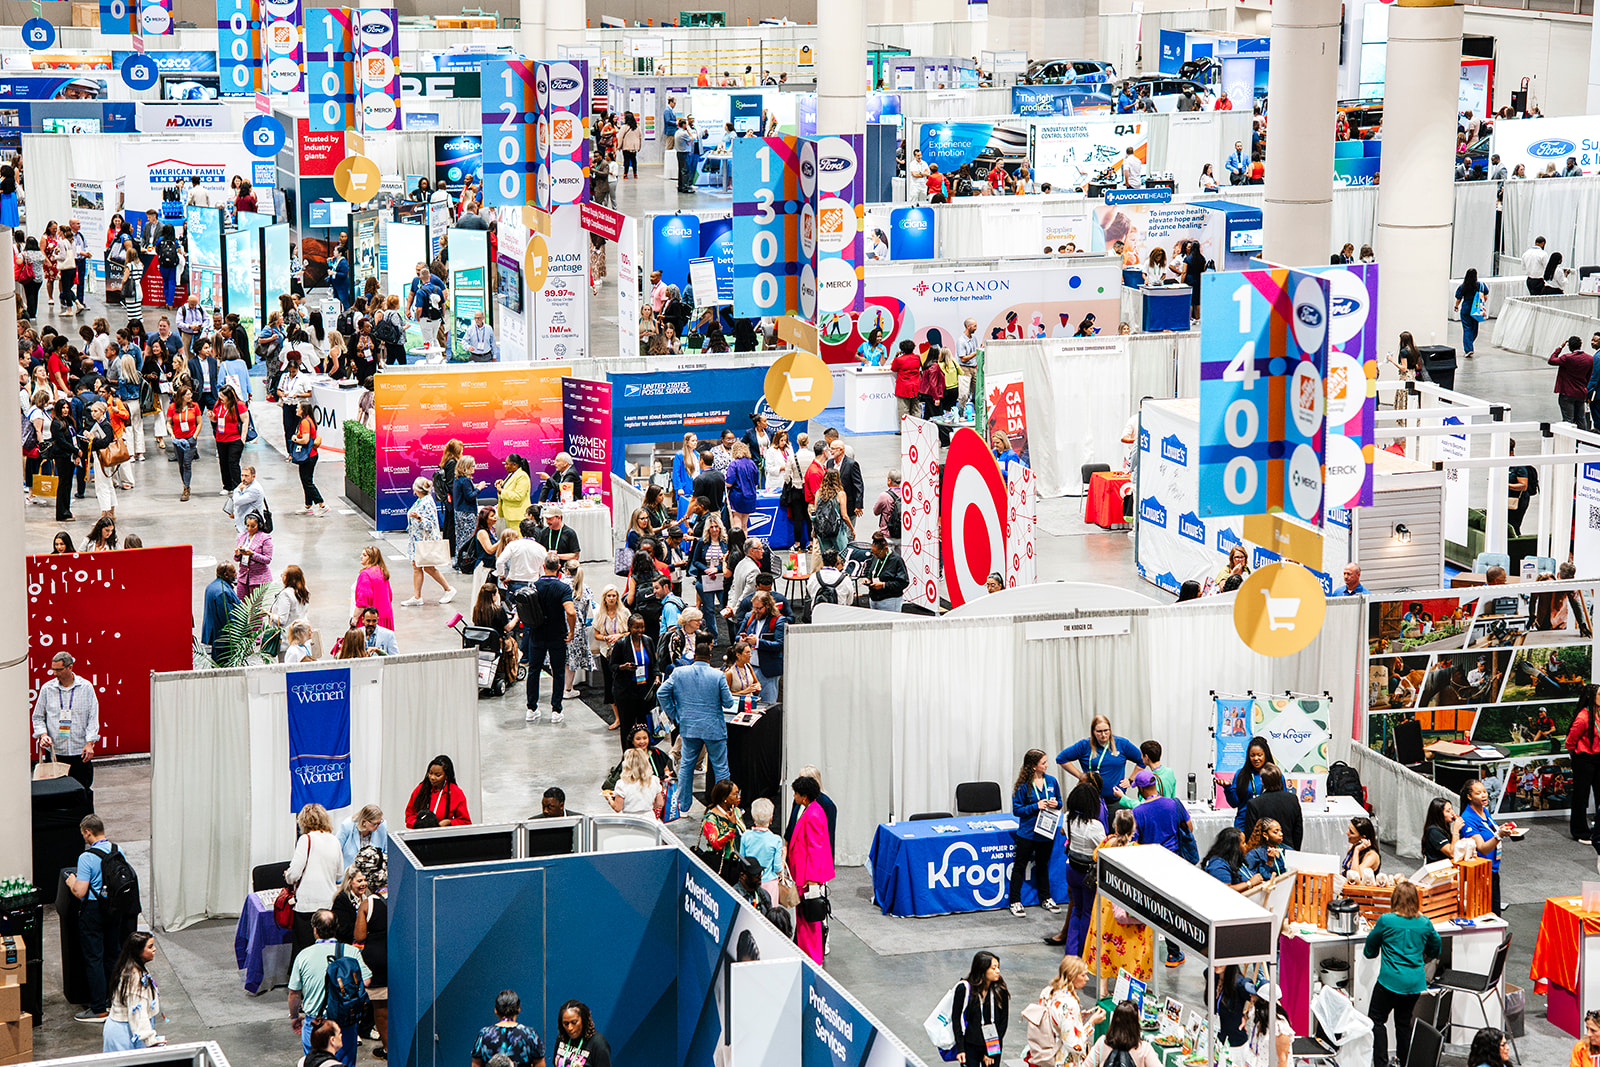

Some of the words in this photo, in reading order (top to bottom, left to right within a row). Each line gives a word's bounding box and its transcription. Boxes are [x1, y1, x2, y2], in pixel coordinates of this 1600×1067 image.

[366, 25, 386, 34] Ford
[322, 15, 341, 124] 1100
[552, 80, 573, 89] Ford
[1020, 94, 1035, 102] The
[1036, 94, 1054, 104] right
[498, 69, 520, 199] 1200
[1114, 124, 1141, 136] QA1
[304, 135, 329, 143] Trusted
[330, 136, 339, 144] by
[929, 141, 972, 150] Experience
[304, 152, 327, 160] giants.
[938, 149, 965, 157] motion
[1537, 142, 1567, 157] Ford
[819, 159, 844, 170] Ford
[1158, 209, 1184, 217] improve
[1186, 207, 1209, 216] health,
[820, 208, 843, 233] HOME
[1174, 216, 1190, 224] hope
[1178, 222, 1202, 231] healing
[752, 147, 779, 309] 1300
[555, 254, 581, 262] ALOM
[826, 281, 851, 289] MERCK
[932, 279, 1011, 294] ORGANON
[933, 295, 949, 303] Here
[1006, 390, 1021, 405] CA
[1222, 284, 1261, 505] 1400
[1006, 404, 1023, 419] NA
[1008, 417, 1024, 432] DA
[569, 434, 606, 449] WOMEN
[569, 445, 605, 460] OWNED
[1142, 505, 1165, 527] LOWE'S
[1180, 520, 1203, 541] LOWE'S
[291, 680, 346, 694] enterprising
[296, 689, 345, 704] Women
[1283, 728, 1312, 743] Kroger
[295, 761, 346, 775] enterprising
[299, 771, 345, 786] Women
[981, 844, 1008, 853] SUPPLIER
[685, 872, 719, 920] Advertising
[1106, 871, 1143, 905] DISCOVER
[1144, 895, 1173, 924] WOMEN
[1175, 915, 1205, 943] OWNED
[684, 894, 690, 913] &
[690, 898, 720, 943] Marketing
[809, 984, 853, 1042] Professional
[815, 1016, 847, 1062] Services
